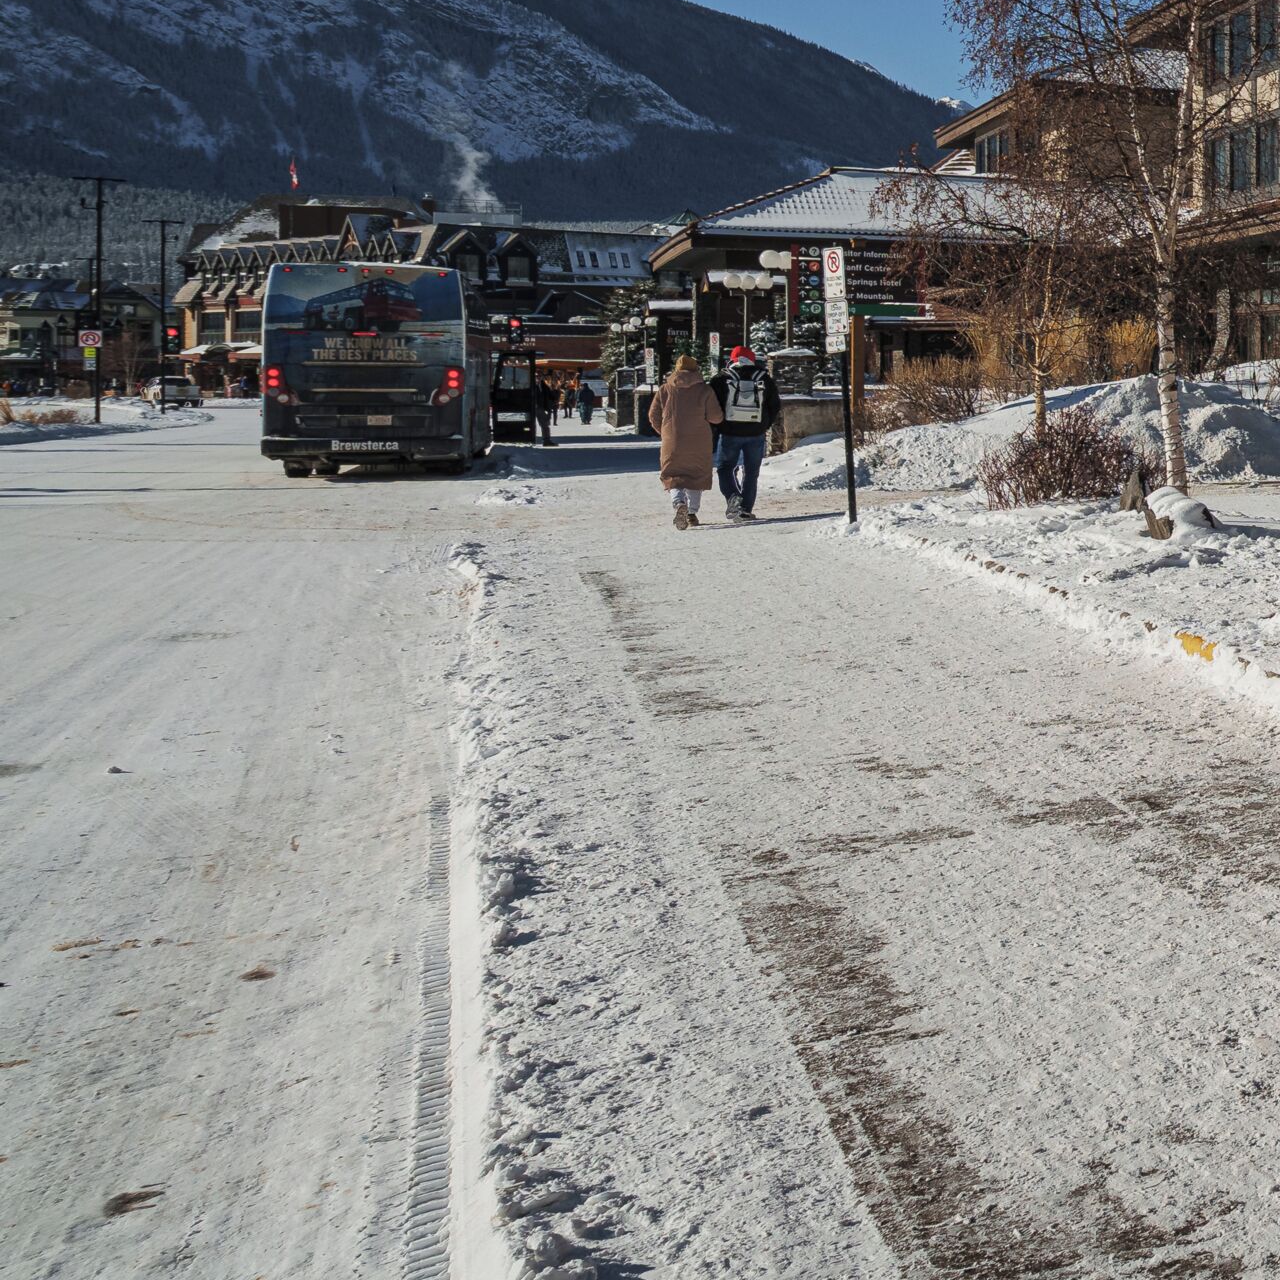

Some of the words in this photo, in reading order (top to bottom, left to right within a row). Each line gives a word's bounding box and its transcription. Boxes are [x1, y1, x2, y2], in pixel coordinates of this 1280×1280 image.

[847, 279, 877, 287] Springs
[667, 328, 689, 336] farm
[324, 337, 343, 349] WE
[346, 337, 383, 350] KNOW
[386, 338, 408, 350] ALL
[312, 348, 336, 360] THE
[339, 349, 369, 361] BEST
[371, 349, 417, 361] PLACES
[331, 440, 399, 451] Brewster.ca
